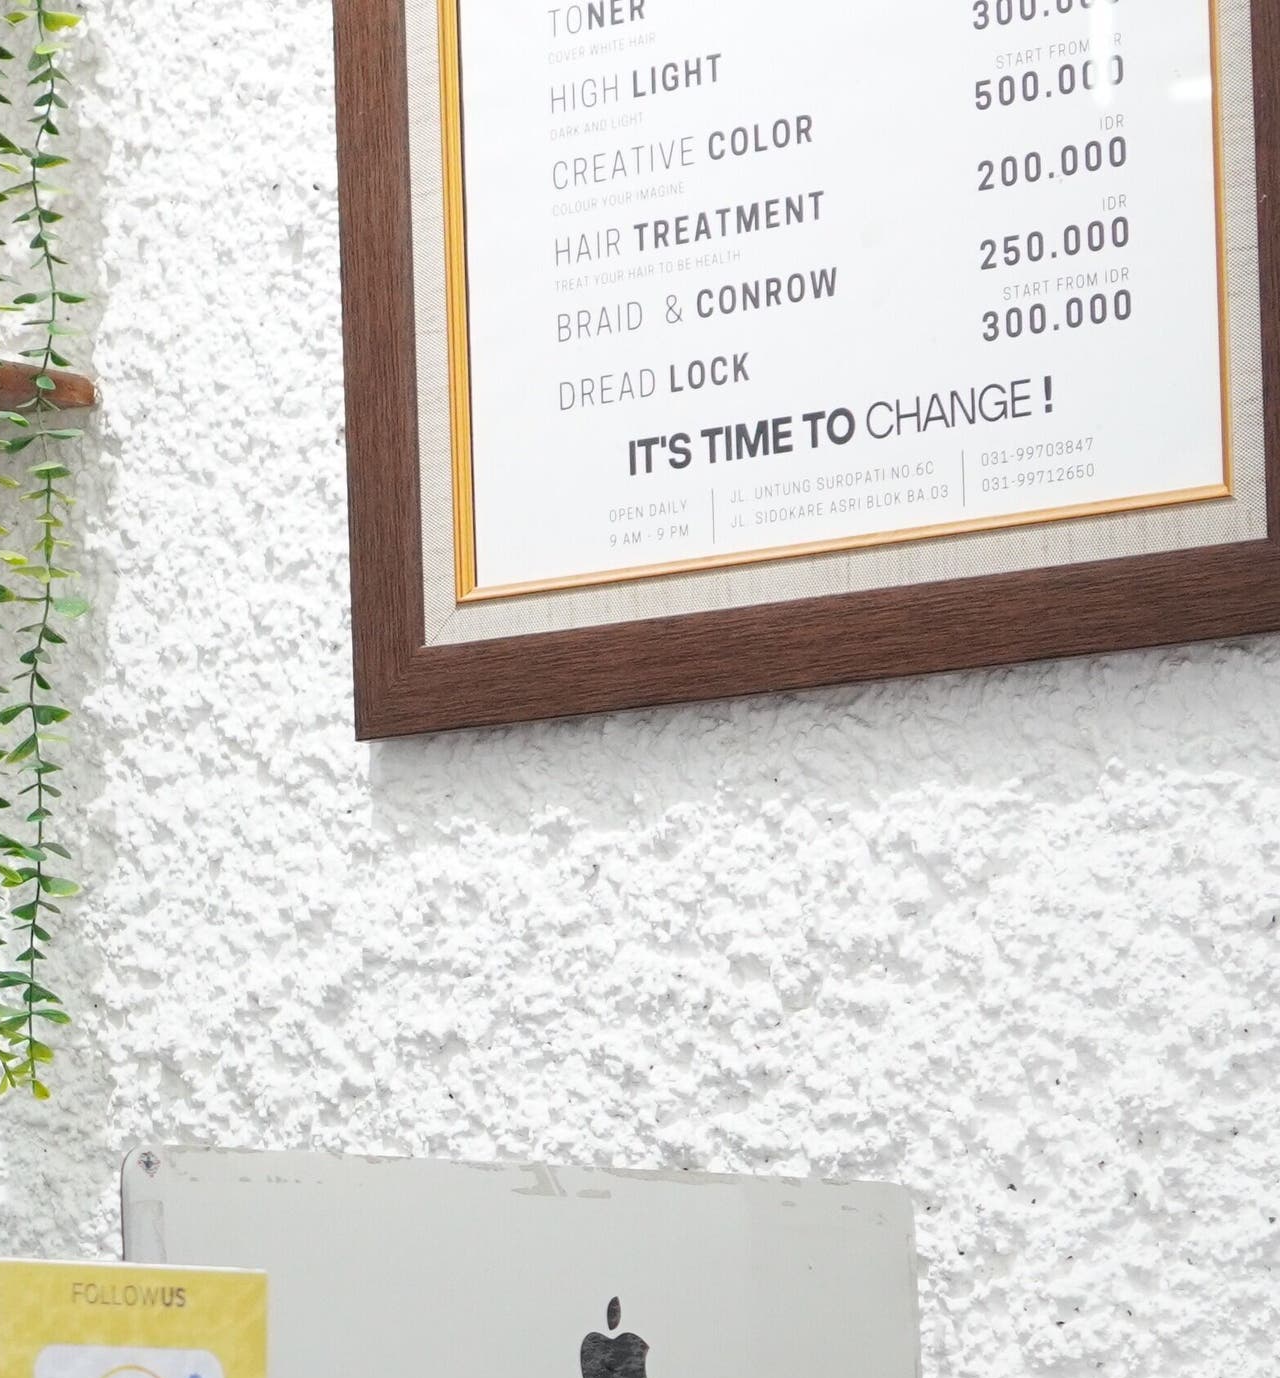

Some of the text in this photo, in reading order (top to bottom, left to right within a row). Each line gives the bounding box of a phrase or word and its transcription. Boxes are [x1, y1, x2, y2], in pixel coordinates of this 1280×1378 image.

[548, 0, 646, 37] TONER
[973, 0, 1120, 30] 300.
[548, 31, 656, 65] COVER WHITE HAIR
[996, 47, 1042, 70] START
[1049, 39, 1090, 59] FROM
[551, 53, 722, 114] HIGH LIGHT
[549, 111, 644, 142] DARK AND LIGHT
[1099, 113, 1125, 131] IDR
[552, 114, 813, 190] CREATIVE COLOR
[977, 136, 1127, 191] 200.000
[552, 182, 685, 217] COLOUR YOUR IMAGINE
[1102, 194, 1127, 211] IDR
[555, 190, 825, 267] HAIR TREATMENT
[980, 216, 1129, 270] 250.000
[555, 250, 742, 293] TREAT YOUR HAIR TO BE HEALTH
[1003, 267, 1130, 301] START FROM IDR
[557, 267, 838, 343] BRAID & CONROW
[982, 289, 1132, 342] 300.000
[559, 352, 750, 411] DREAD LOCK
[628, 431, 692, 477] IT'S
[700, 415, 794, 464] TIME
[802, 407, 856, 449] TO
[866, 378, 1032, 440] CHANGE
[981, 437, 1094, 467] 031-99703847
[754, 479, 811, 501] UNTUNG
[816, 467, 886, 492] SUROPATI
[982, 463, 1095, 492] 031-99712650
[609, 499, 688, 523] OPEN DAILY
[755, 504, 823, 526] SIDOKARE
[830, 497, 862, 515] ASRI
[867, 491, 903, 510] BLOK
[609, 533, 617, 548] 9
[623, 530, 642, 546] AM
[657, 527, 664, 542] 9
[670, 523, 689, 540] PM
